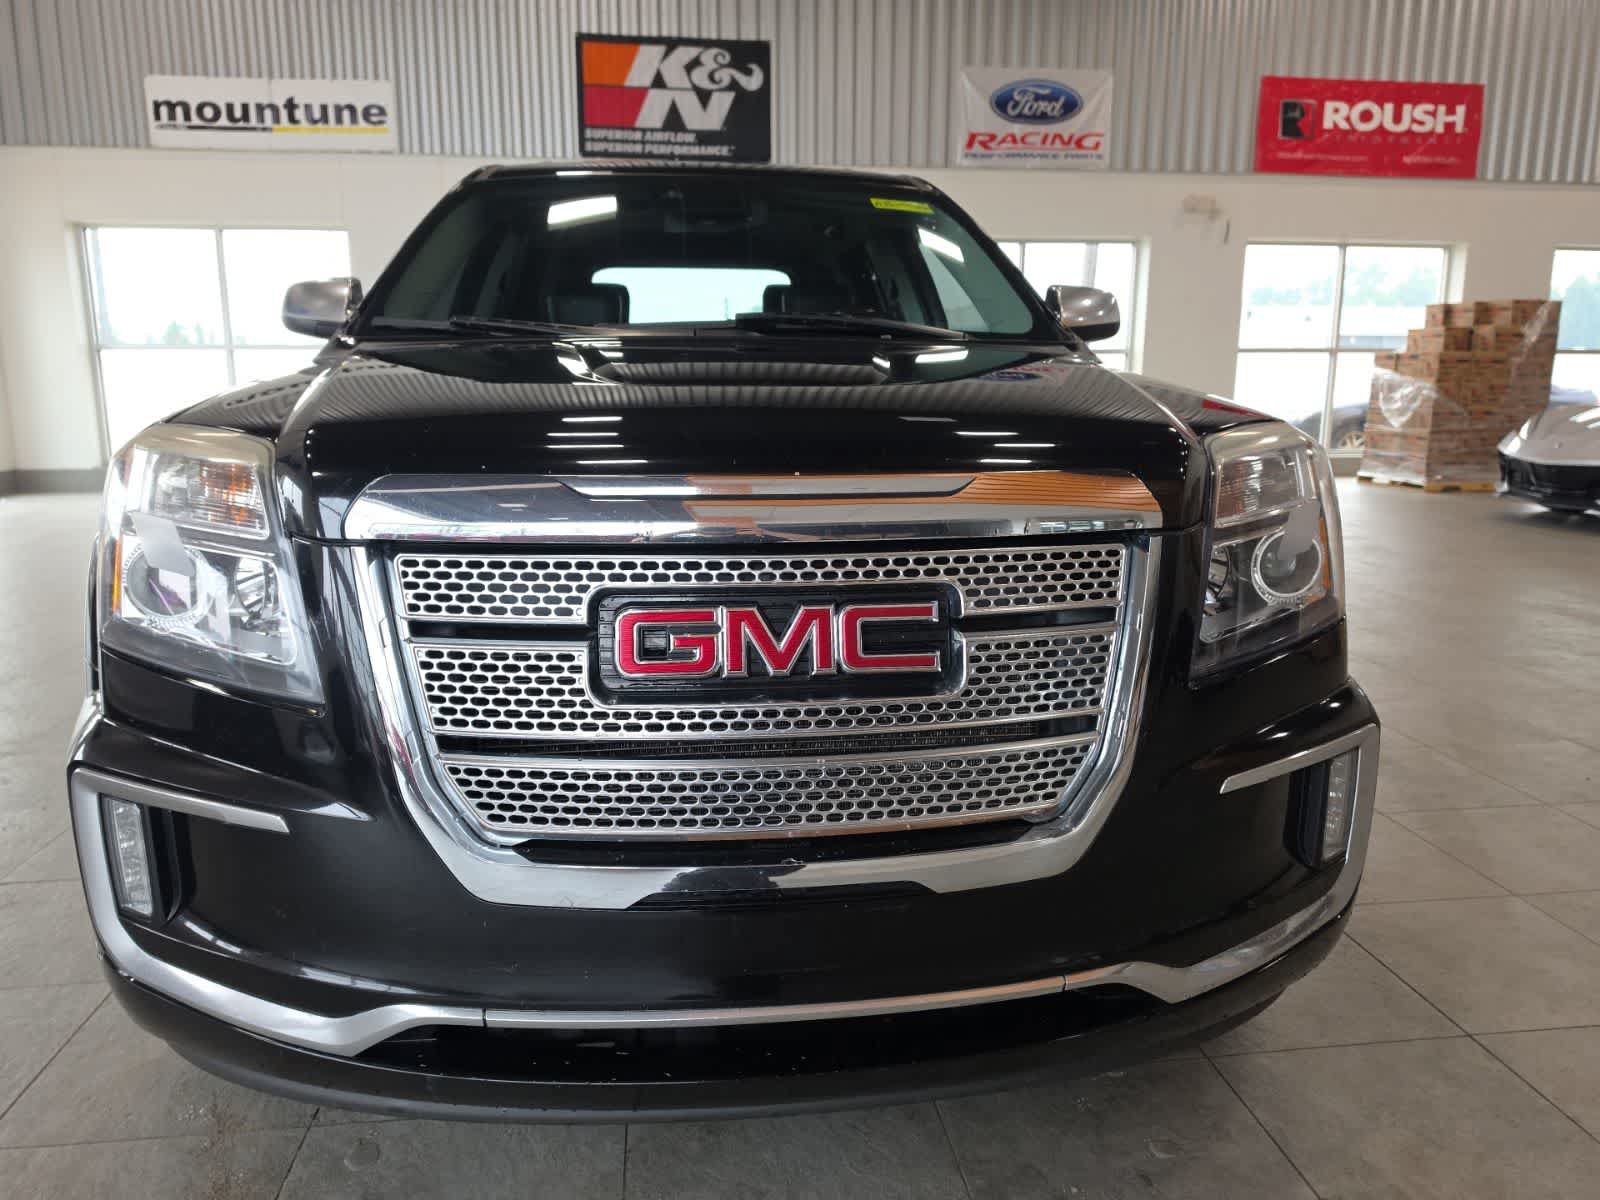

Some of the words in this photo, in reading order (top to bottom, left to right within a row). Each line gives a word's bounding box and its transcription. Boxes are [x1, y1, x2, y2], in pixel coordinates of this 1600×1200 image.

[152, 96, 388, 125] mountune
[1007, 86, 1065, 117] Ford
[1322, 99, 1467, 134] ROUSH
[584, 128, 643, 141] SUPERIOR
[584, 141, 643, 153] SUPERIOR
[965, 130, 1104, 151] RACING
[615, 600, 942, 678] GMC
